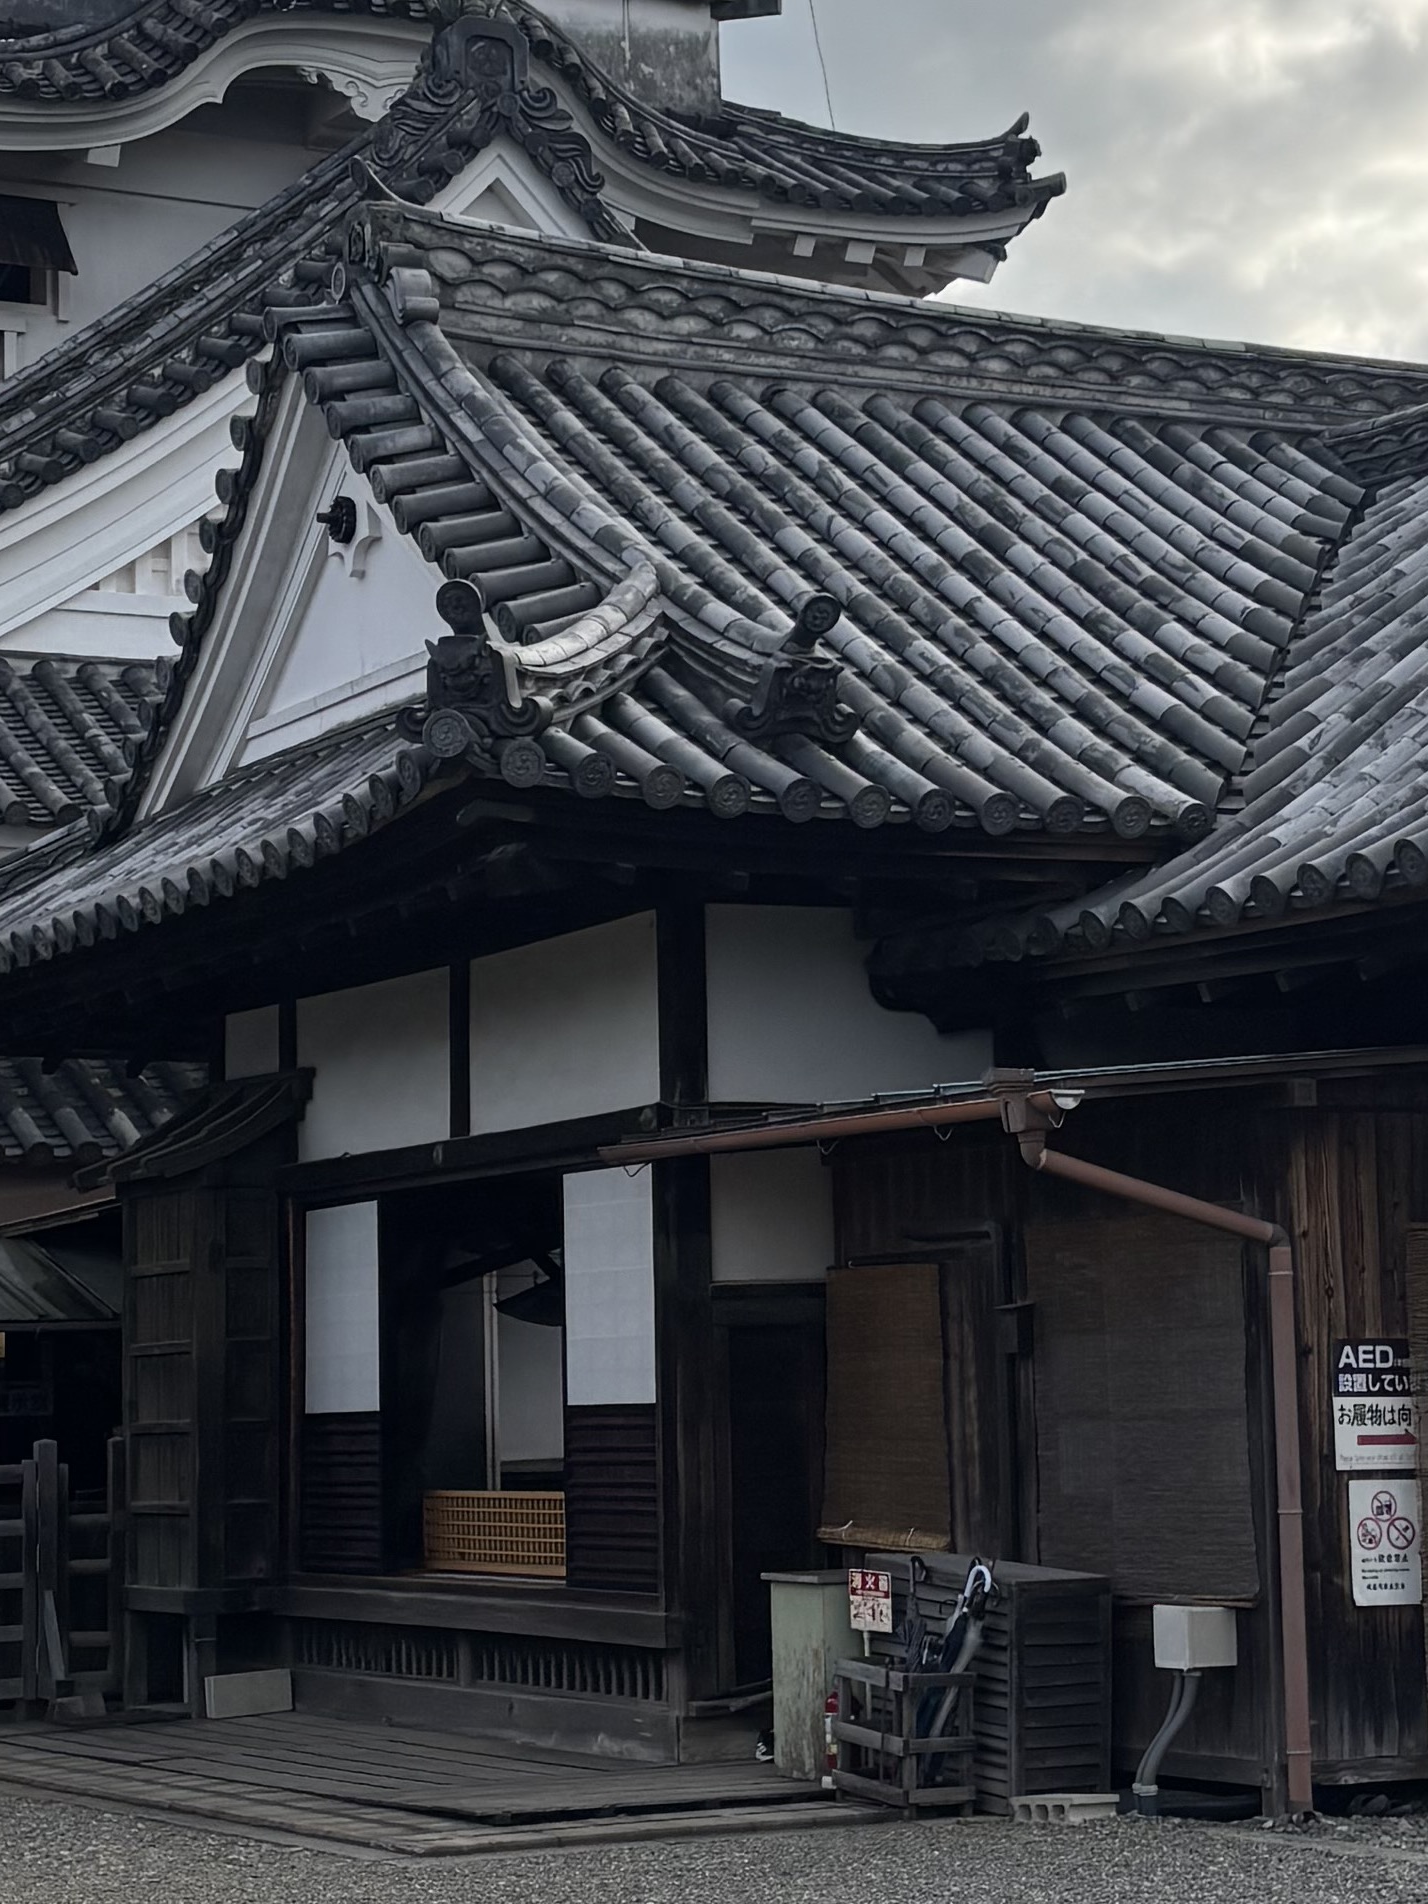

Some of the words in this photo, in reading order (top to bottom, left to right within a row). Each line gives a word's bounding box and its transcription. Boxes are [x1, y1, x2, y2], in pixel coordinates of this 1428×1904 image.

[1338, 1345, 1394, 1369] AED
[1338, 1403, 1414, 1427] お履物は向
